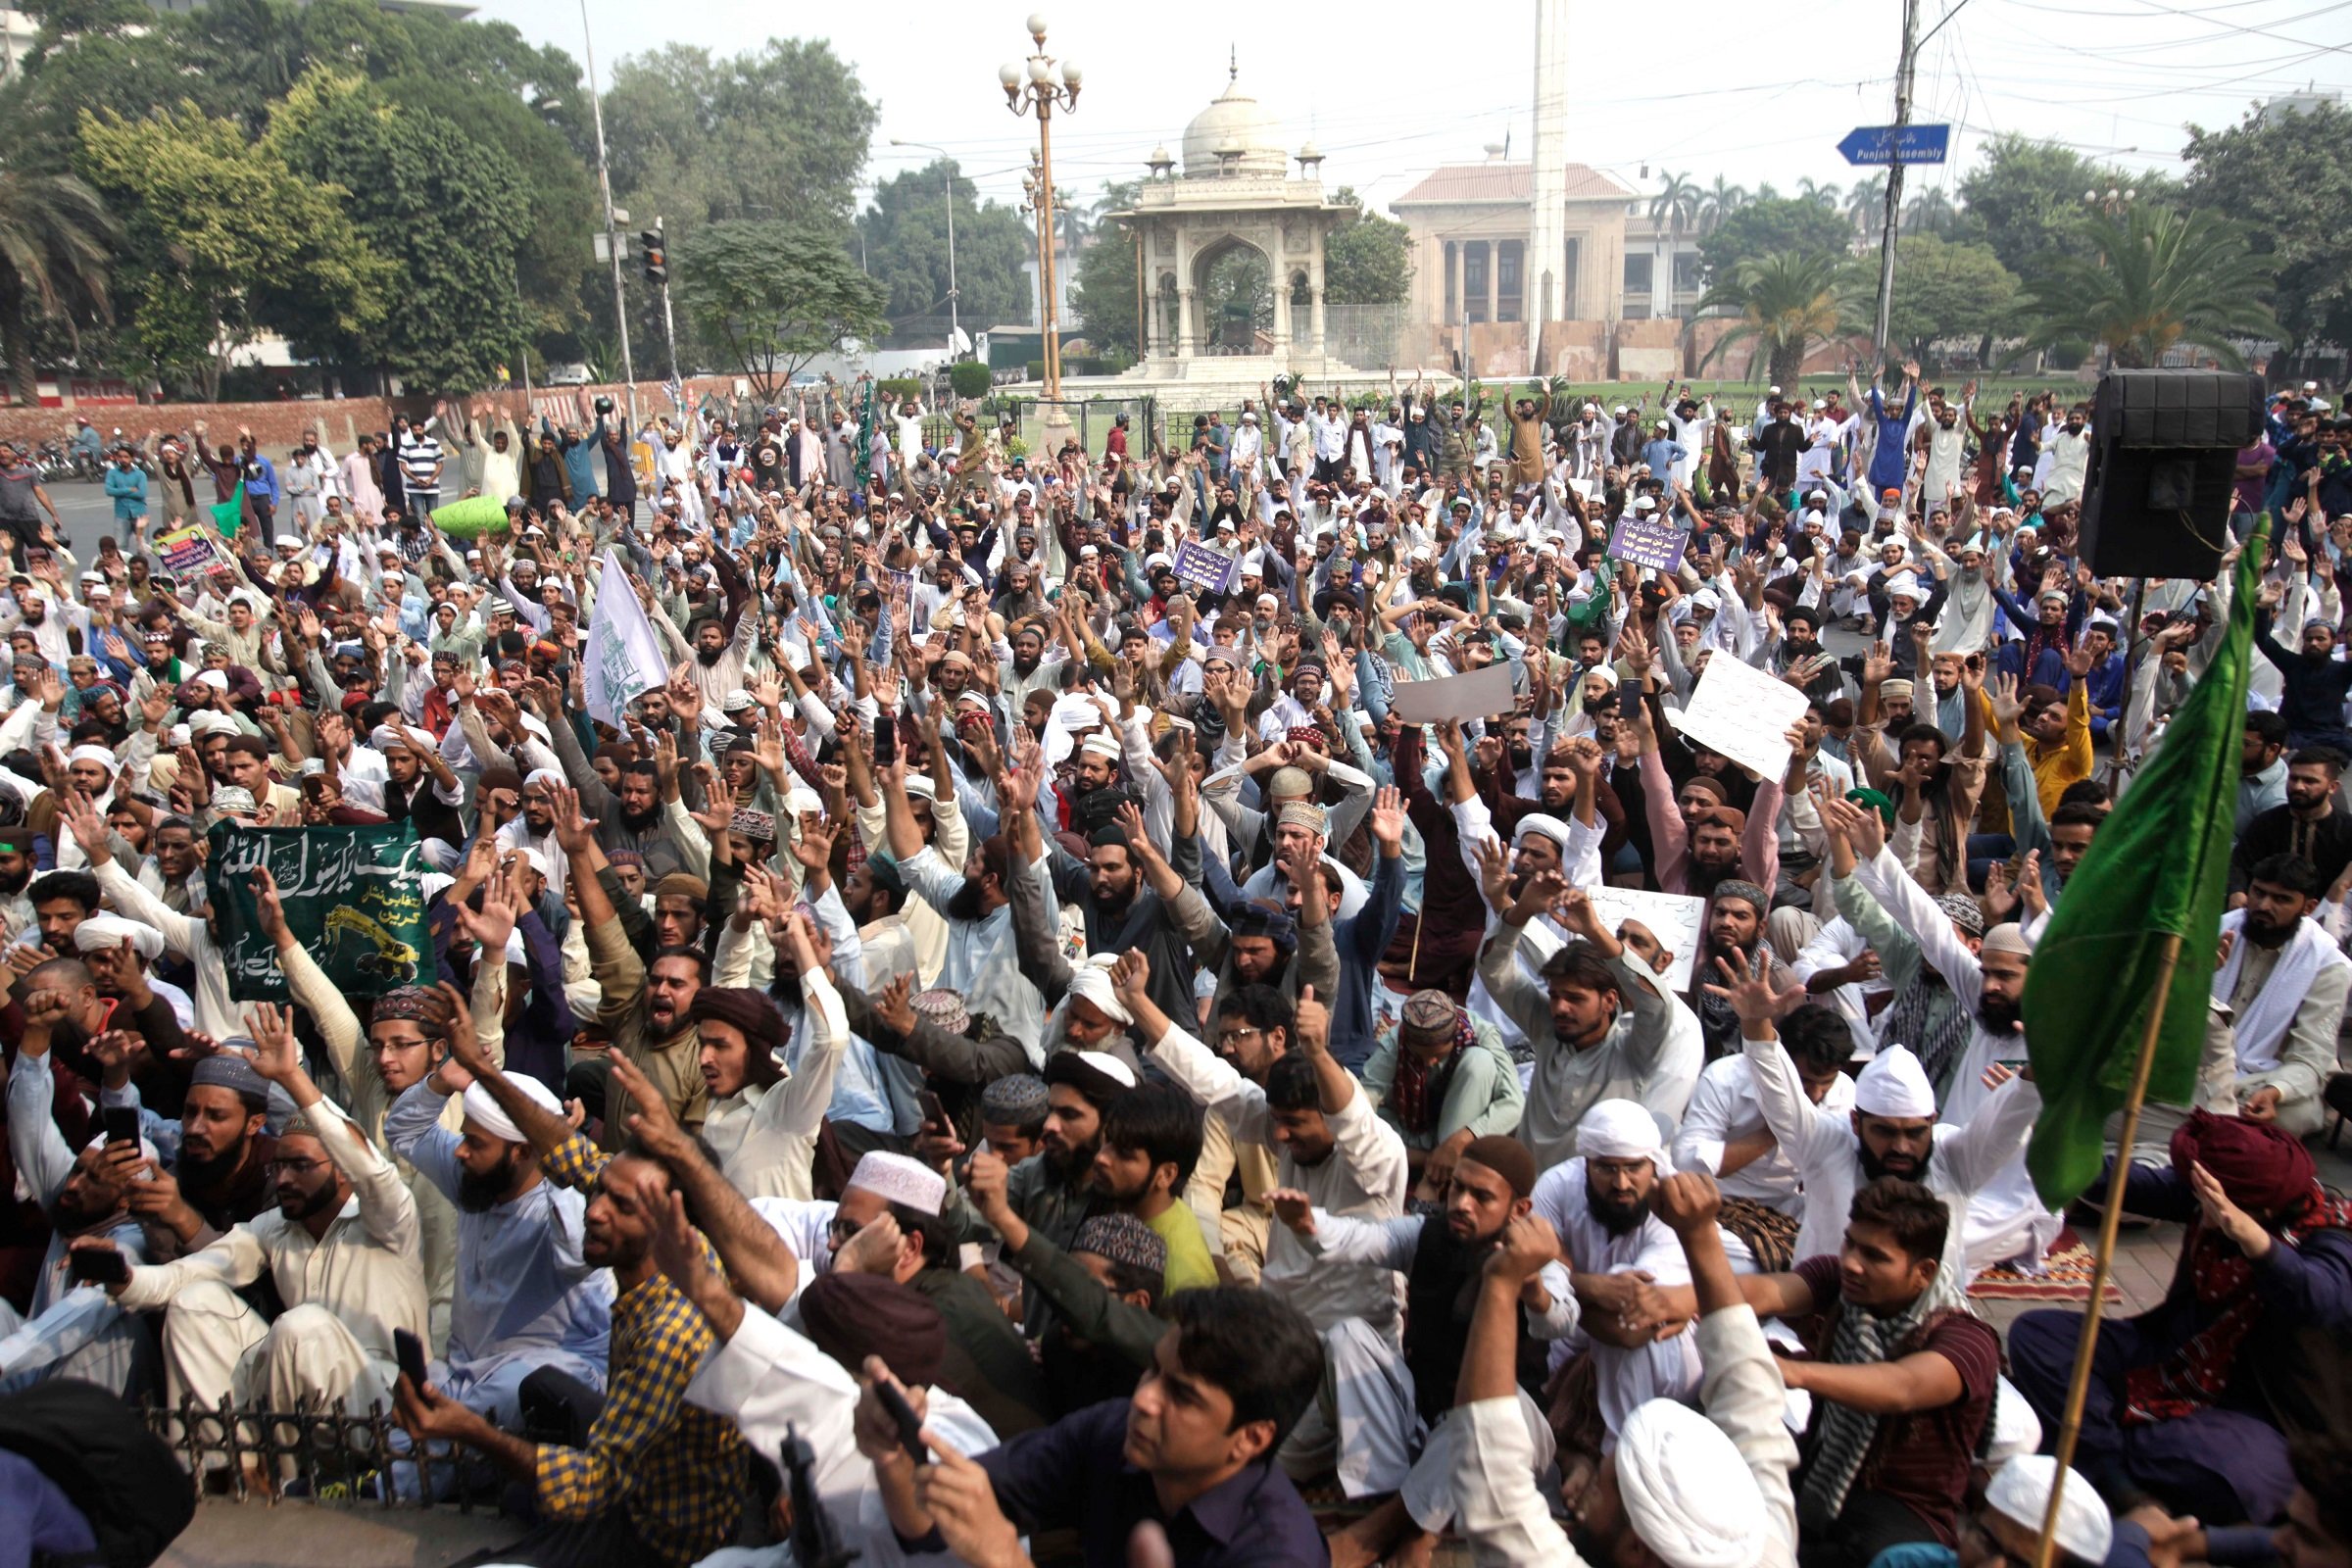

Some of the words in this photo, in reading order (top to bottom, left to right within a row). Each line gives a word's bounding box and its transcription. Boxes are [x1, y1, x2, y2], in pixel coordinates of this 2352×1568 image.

[1857, 149, 1890, 162] Punjab
[1624, 529, 1637, 539] جدا
[1622, 538, 1635, 549] جدا
[1622, 551, 1637, 561] TLP
[1638, 555, 1665, 569] KASUR
[1183, 570, 1194, 579] TLP
[354, 836, 422, 891] بیک
[378, 909, 421, 927] کرین
